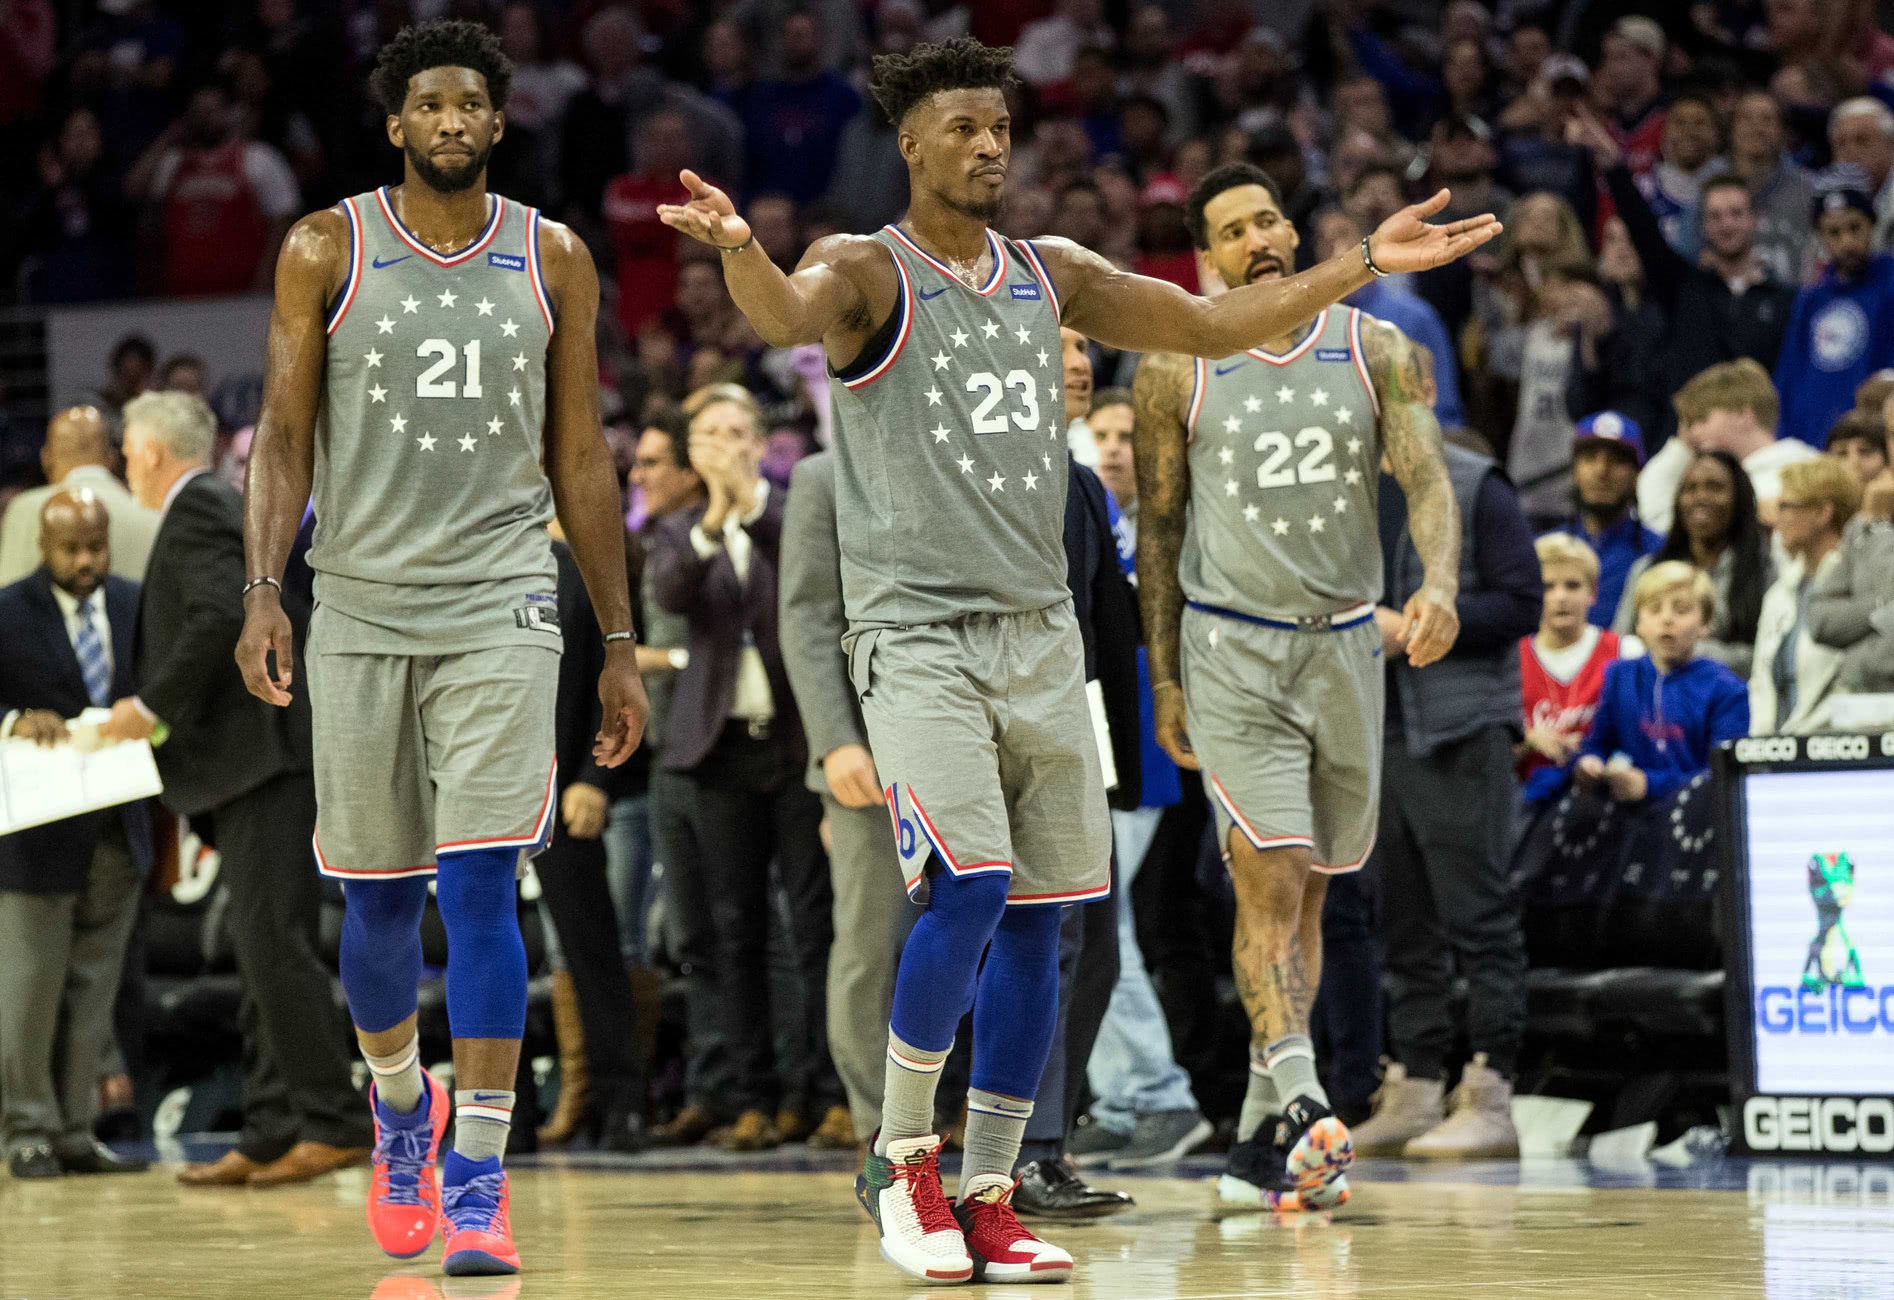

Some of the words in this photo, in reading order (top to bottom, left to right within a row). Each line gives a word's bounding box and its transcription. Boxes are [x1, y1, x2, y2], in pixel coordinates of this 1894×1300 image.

[492, 256, 522, 268] StubHub
[416, 338, 482, 399] 21
[965, 369, 1040, 435] 23
[1253, 426, 1336, 489] 22
[1735, 738, 1797, 763] GEICO
[1806, 735, 1869, 760] GEICO
[1744, 1097, 1894, 1152] GEICO
